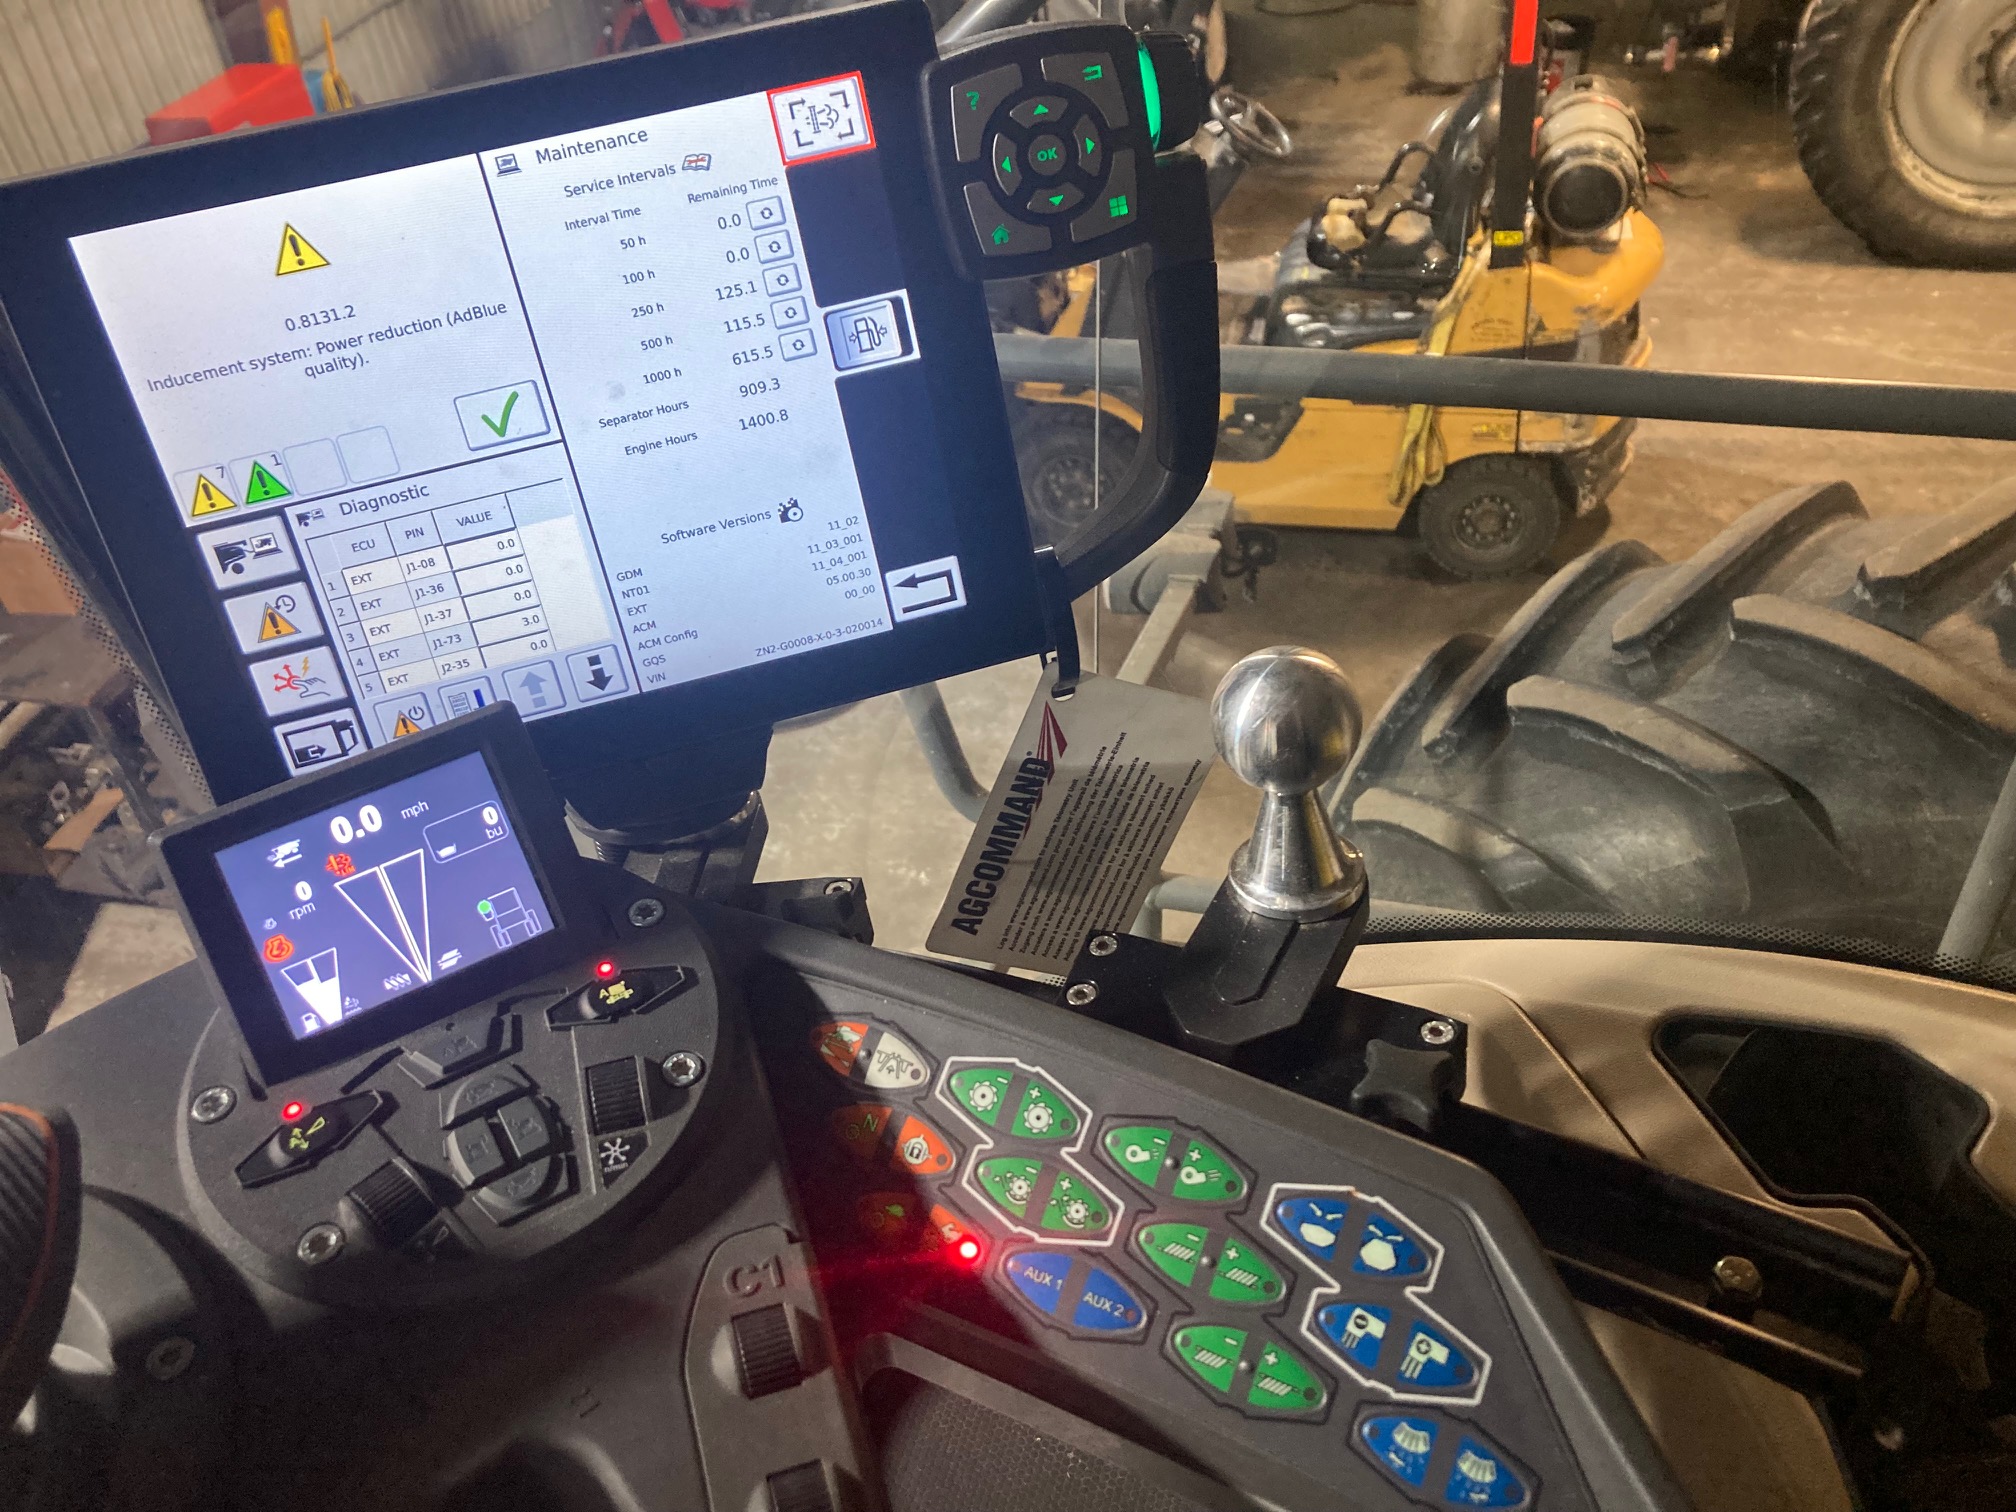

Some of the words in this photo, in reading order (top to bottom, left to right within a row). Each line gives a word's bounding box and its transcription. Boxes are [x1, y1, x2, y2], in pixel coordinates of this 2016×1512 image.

[535, 127, 649, 164] Maintenance
[1037, 147, 1058, 162] OK
[563, 177, 615, 198] Service
[617, 162, 677, 187] Intervals
[687, 182, 748, 205] Remaining
[749, 175, 779, 191] Time
[564, 211, 610, 231] Interval
[611, 205, 642, 221] Time
[717, 213, 742, 230] 0.0
[620, 238, 636, 250] 50
[638, 235, 647, 247] h
[725, 247, 750, 264] 0.0
[622, 271, 645, 285] 100
[647, 269, 656, 280] h
[715, 281, 758, 301] 125.1
[284, 304, 357, 333] 0.8131.2
[631, 304, 654, 318] 250
[655, 302, 665, 313] h
[723, 313, 766, 333] 115.5
[147, 359, 247, 393] Inducement
[248, 344, 313, 376] system:
[316, 332, 365, 357] Power
[368, 314, 443, 344] reduction
[445, 300, 508, 330] (AdBlue
[640, 337, 663, 351] 500
[664, 335, 674, 346] h
[304, 353, 371, 380] quality).
[732, 346, 774, 366] 615.5
[643, 369, 672, 385] 1000
[673, 367, 682, 378] h
[739, 378, 781, 398] 909.3
[598, 408, 654, 430] Separator
[656, 400, 690, 417] Hours
[738, 409, 789, 431] 1400.8
[624, 438, 663, 458] Engine
[664, 431, 698, 448] Hours
[271, 454, 282, 467] 1
[216, 466, 226, 480] 7
[338, 483, 430, 517] Diagnostic
[351, 537, 376, 554] ECU
[404, 526, 425, 541] PIN
[455, 510, 494, 528] VALUE
[660, 520, 717, 545] Software
[719, 508, 772, 532] Versions
[827, 515, 860, 532] 11_02
[807, 533, 864, 555] 11_03_001
[328, 581, 336, 592] 1
[350, 571, 374, 586] EXT
[406, 556, 436, 575] J1-08
[497, 538, 516, 552] 0.0
[811, 550, 868, 572] 11_04_001
[616, 567, 643, 583] GDM
[825, 567, 872, 587] 05.00.30
[338, 607, 346, 618] 2
[360, 597, 383, 612] EXT
[414, 582, 445, 600] J1-36
[505, 563, 524, 577] 0.0
[621, 585, 651, 600] NT01
[844, 583, 877, 601] 00_00
[346, 632, 355, 643] 3
[369, 622, 392, 637] EXT
[423, 607, 453, 626] J1-37
[514, 588, 532, 602] 0.0
[627, 603, 649, 617] EXT
[632, 620, 657, 635] ACM
[755, 617, 884, 658] ZN2-G0008-X-0-3-020014
[355, 657, 364, 668] 4
[378, 647, 400, 662] EXT
[432, 633, 462, 651] J1-73
[523, 613, 540, 627] 3.0
[637, 637, 662, 652] ACM
[663, 627, 699, 647] Config
[365, 682, 373, 693] 5
[387, 672, 409, 687] EXT
[441, 657, 471, 676] J2-35
[530, 638, 548, 652] 0.0
[642, 654, 667, 669] GQS
[646, 671, 667, 684] VIN
[330, 804, 383, 845] 0.0
[401, 800, 430, 823] mph
[482, 805, 499, 826] 0
[485, 824, 503, 840] bu
[951, 757, 1051, 937] AGCOMMAND
[295, 880, 313, 902] 0
[289, 900, 316, 921] rpm
[863, 1113, 879, 1132] N
[724, 1257, 786, 1297] C1
[1024, 1265, 1053, 1287] AUX
[1056, 1278, 1064, 1291] 1
[1082, 1290, 1113, 1312] AUX
[1113, 1304, 1125, 1317] 2
